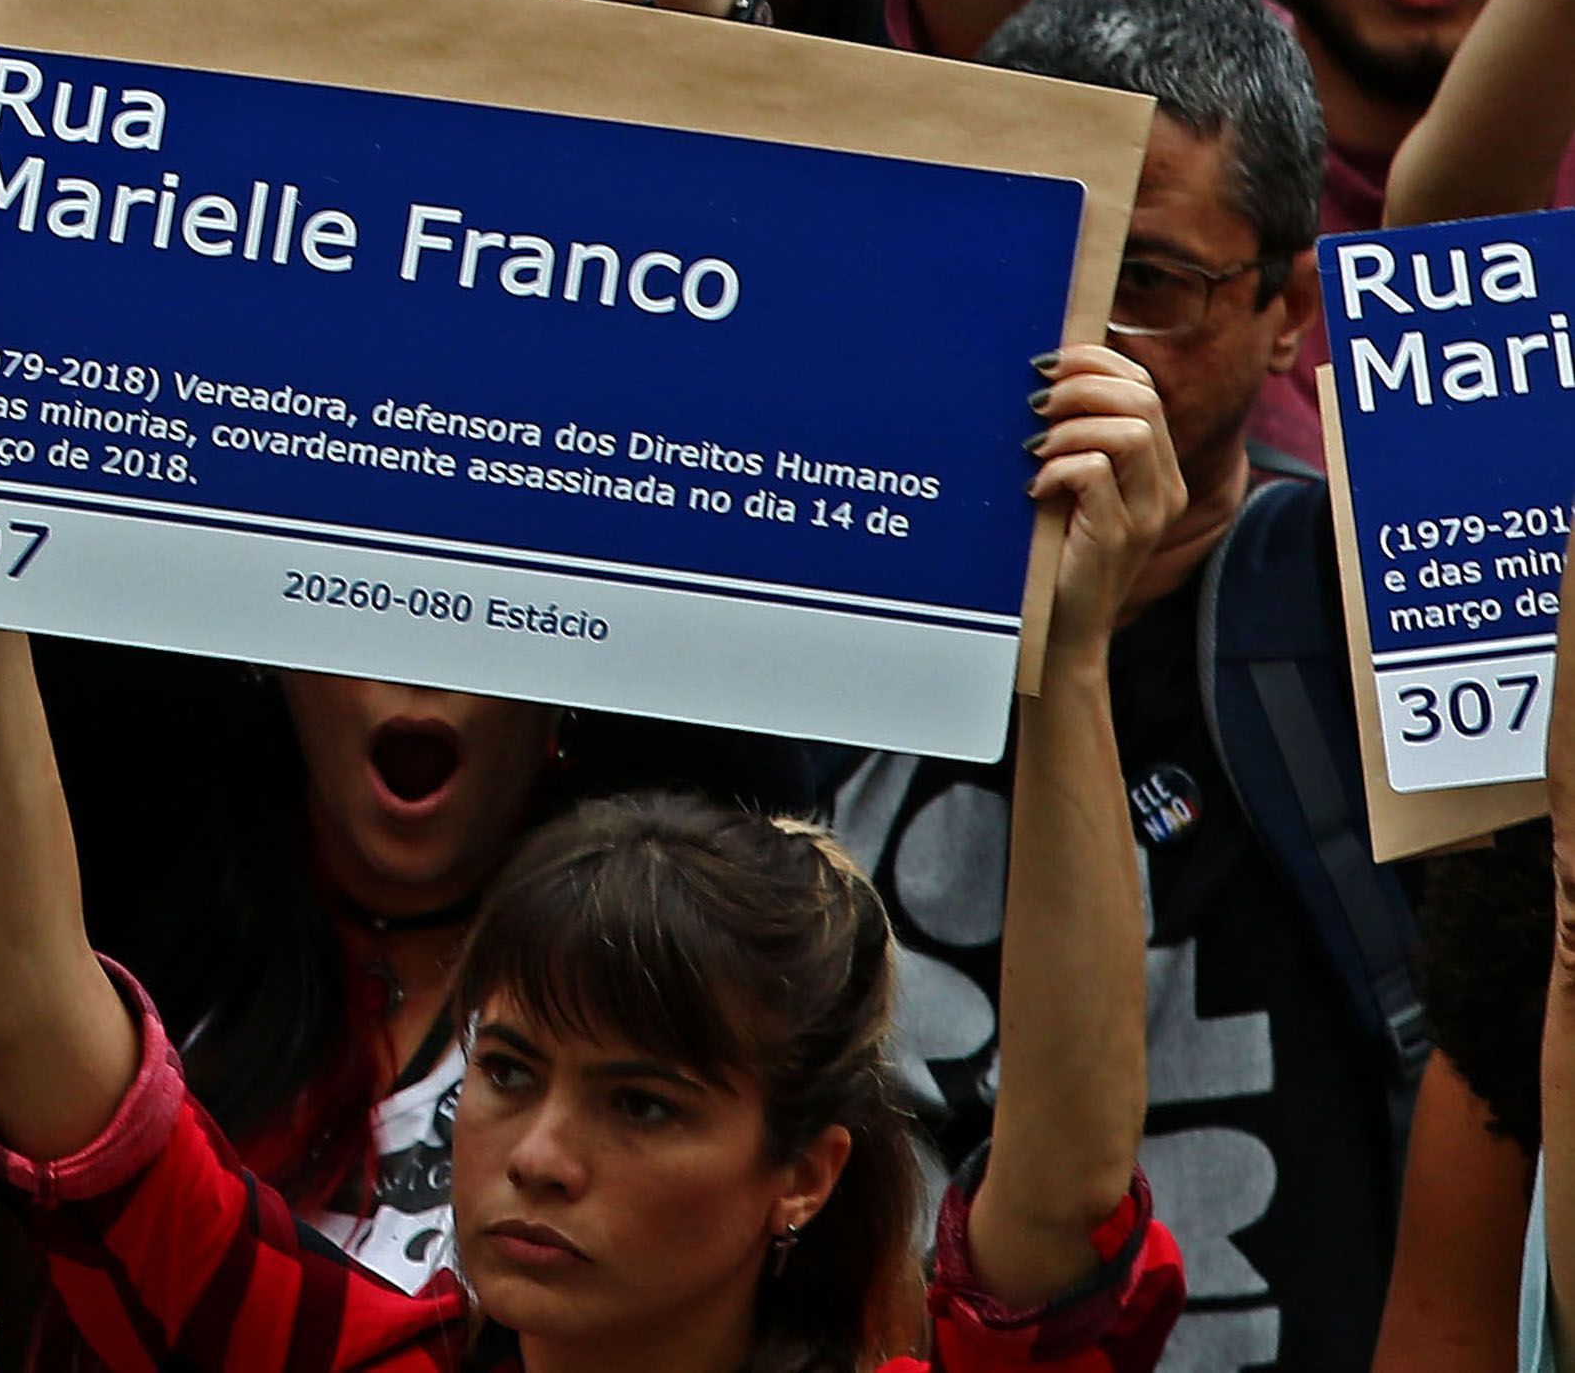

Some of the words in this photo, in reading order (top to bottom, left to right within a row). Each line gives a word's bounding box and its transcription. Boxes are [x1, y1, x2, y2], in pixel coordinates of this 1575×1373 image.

[400, 204, 740, 321] Franco
[1339, 242, 1538, 320] Rua
[40, 399, 198, 449] minorias,
[211, 424, 457, 478] covardemente
[467, 457, 675, 507] assassinada
[689, 487, 732, 514] no
[744, 488, 796, 522] dia
[810, 498, 854, 530] 14
[865, 505, 909, 538] de
[47, 438, 90, 470] de
[100, 445, 198, 485] 2018.
[173, 371, 358, 429] Vereadora,
[371, 398, 542, 448] defensora
[554, 422, 617, 457] dos
[628, 431, 764, 476] Direitos
[776, 450, 940, 500] Humanos
[282, 571, 473, 623] 20260-080
[485, 598, 609, 641] Estácio
[1389, 599, 1503, 631] março
[1515, 588, 1562, 617] de
[1398, 675, 1542, 743] 307
[1130, 772, 1171, 815] ELE
